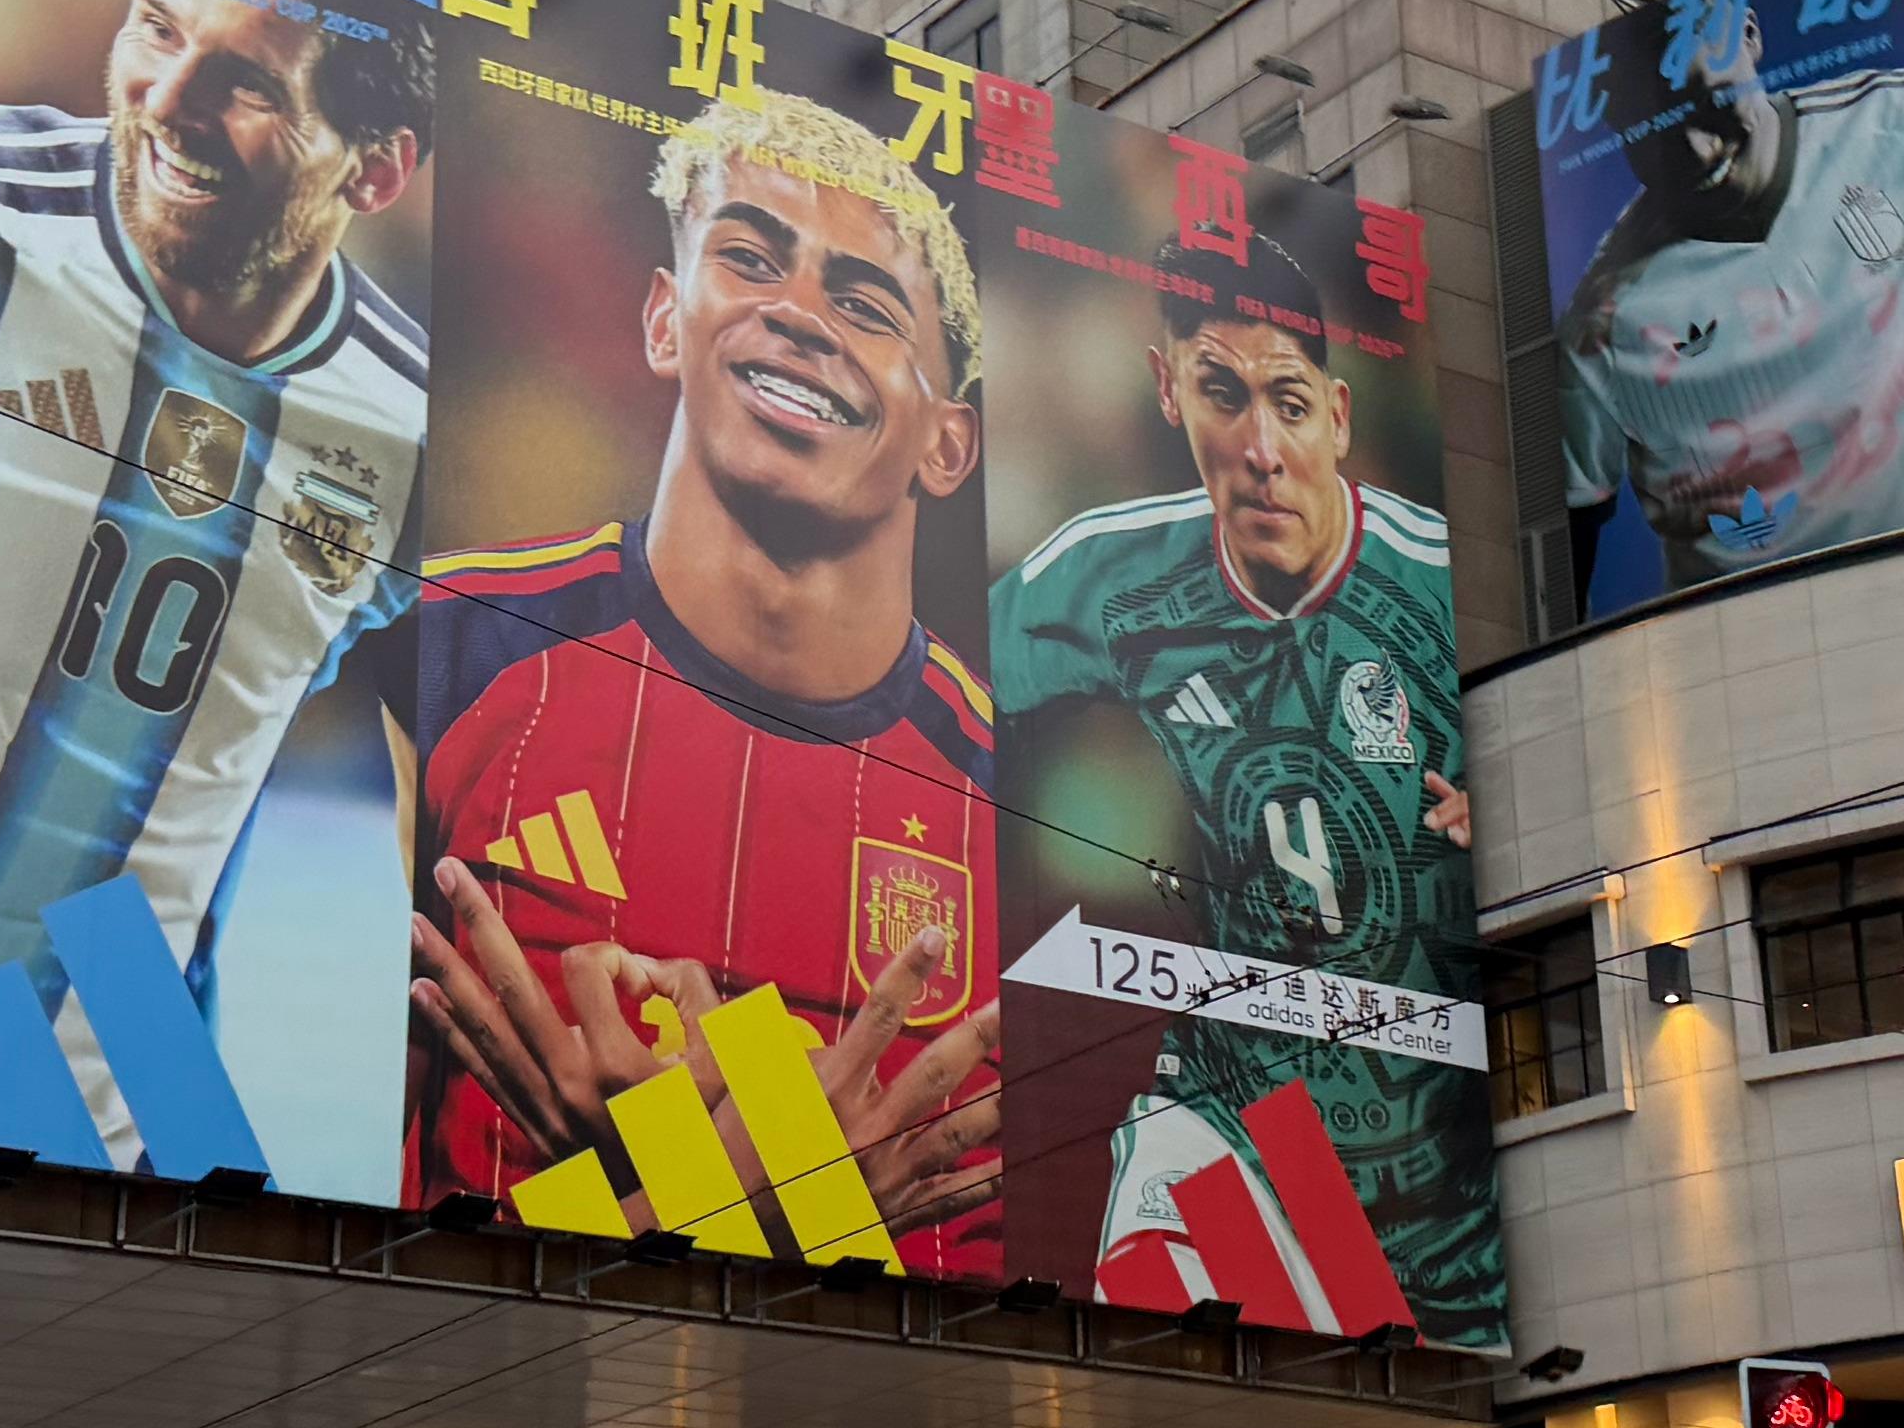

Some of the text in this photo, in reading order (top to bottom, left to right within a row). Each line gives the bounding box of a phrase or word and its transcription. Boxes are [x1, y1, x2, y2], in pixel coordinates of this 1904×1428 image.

[58, 519, 228, 715] 10
[1352, 743, 1414, 761] MEXICO
[1263, 796, 1343, 935] 4
[1247, 1000, 1316, 1029] adidas
[1388, 1025, 1453, 1055] Center
